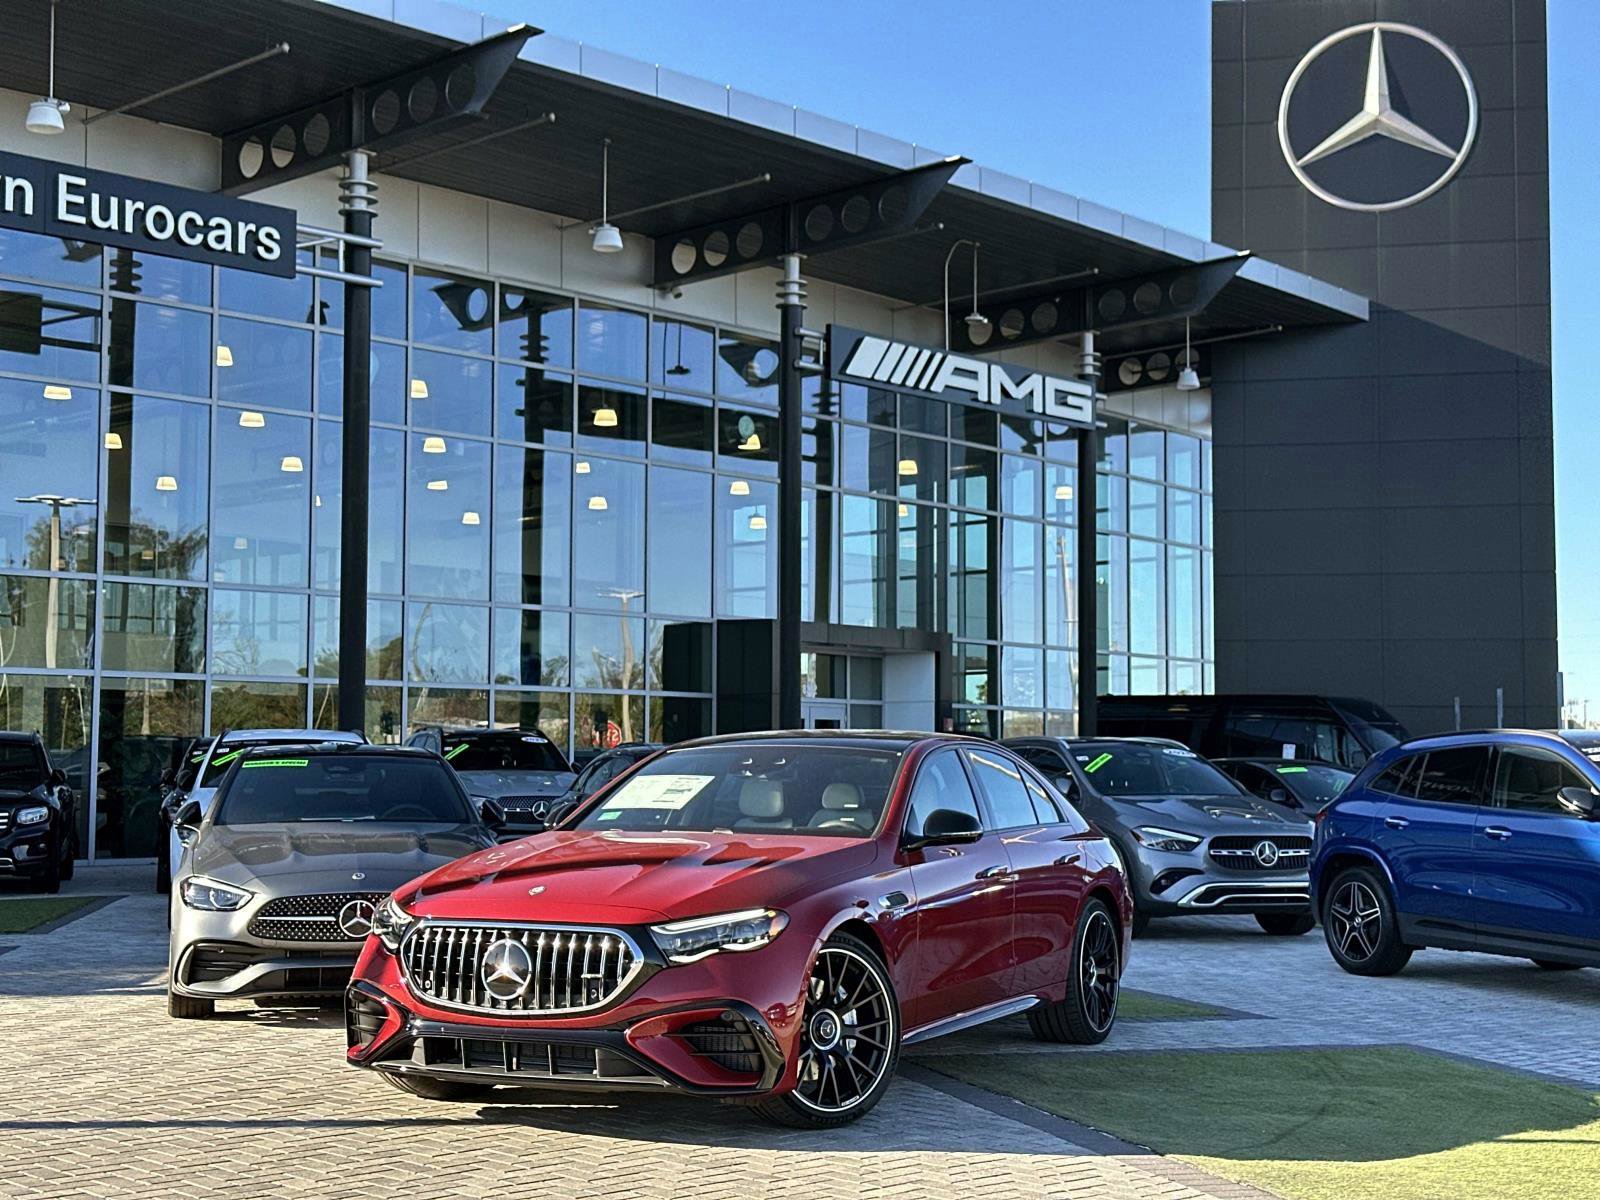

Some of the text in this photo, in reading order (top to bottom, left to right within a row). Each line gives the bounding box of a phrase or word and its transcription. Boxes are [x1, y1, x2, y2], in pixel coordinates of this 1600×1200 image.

[0, 173, 281, 261] n Eurocars
[930, 354, 1093, 423] AMG
